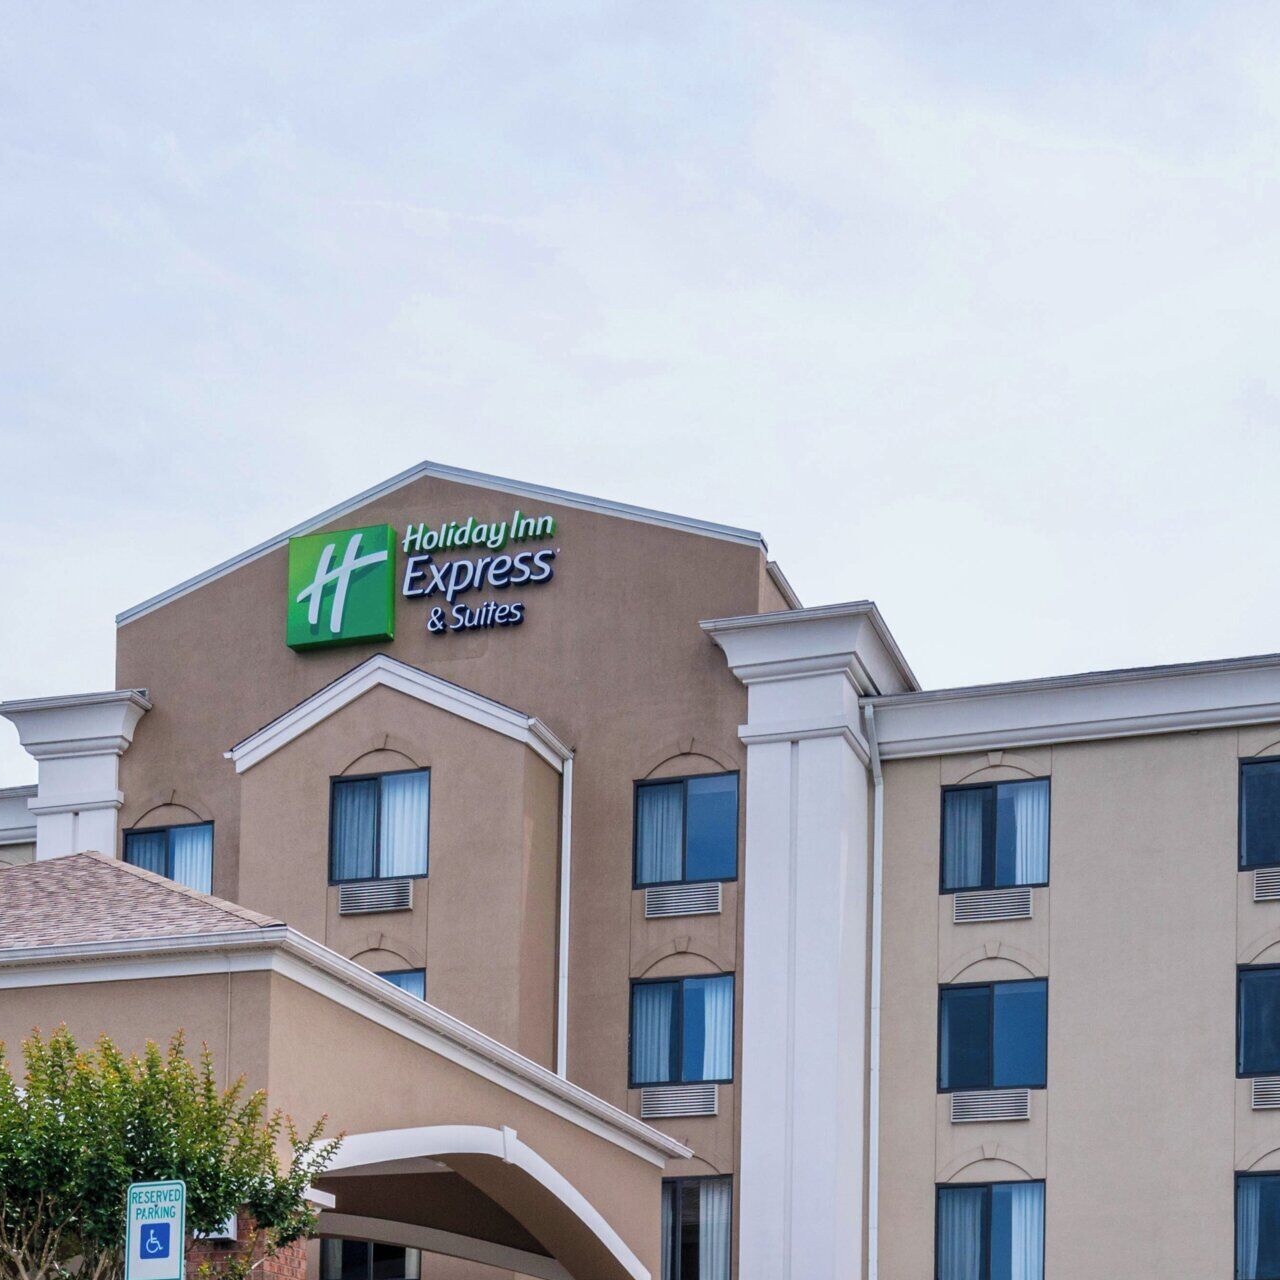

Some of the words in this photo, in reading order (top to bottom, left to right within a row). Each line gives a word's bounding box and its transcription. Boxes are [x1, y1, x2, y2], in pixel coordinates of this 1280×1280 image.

[401, 516, 508, 552] Holiday
[510, 510, 556, 539] Inn
[402, 548, 556, 602] Express
[427, 606, 447, 634] &
[449, 600, 524, 631] Suites
[131, 1188, 181, 1204] RESERVED
[135, 1205, 176, 1220] PARKING
